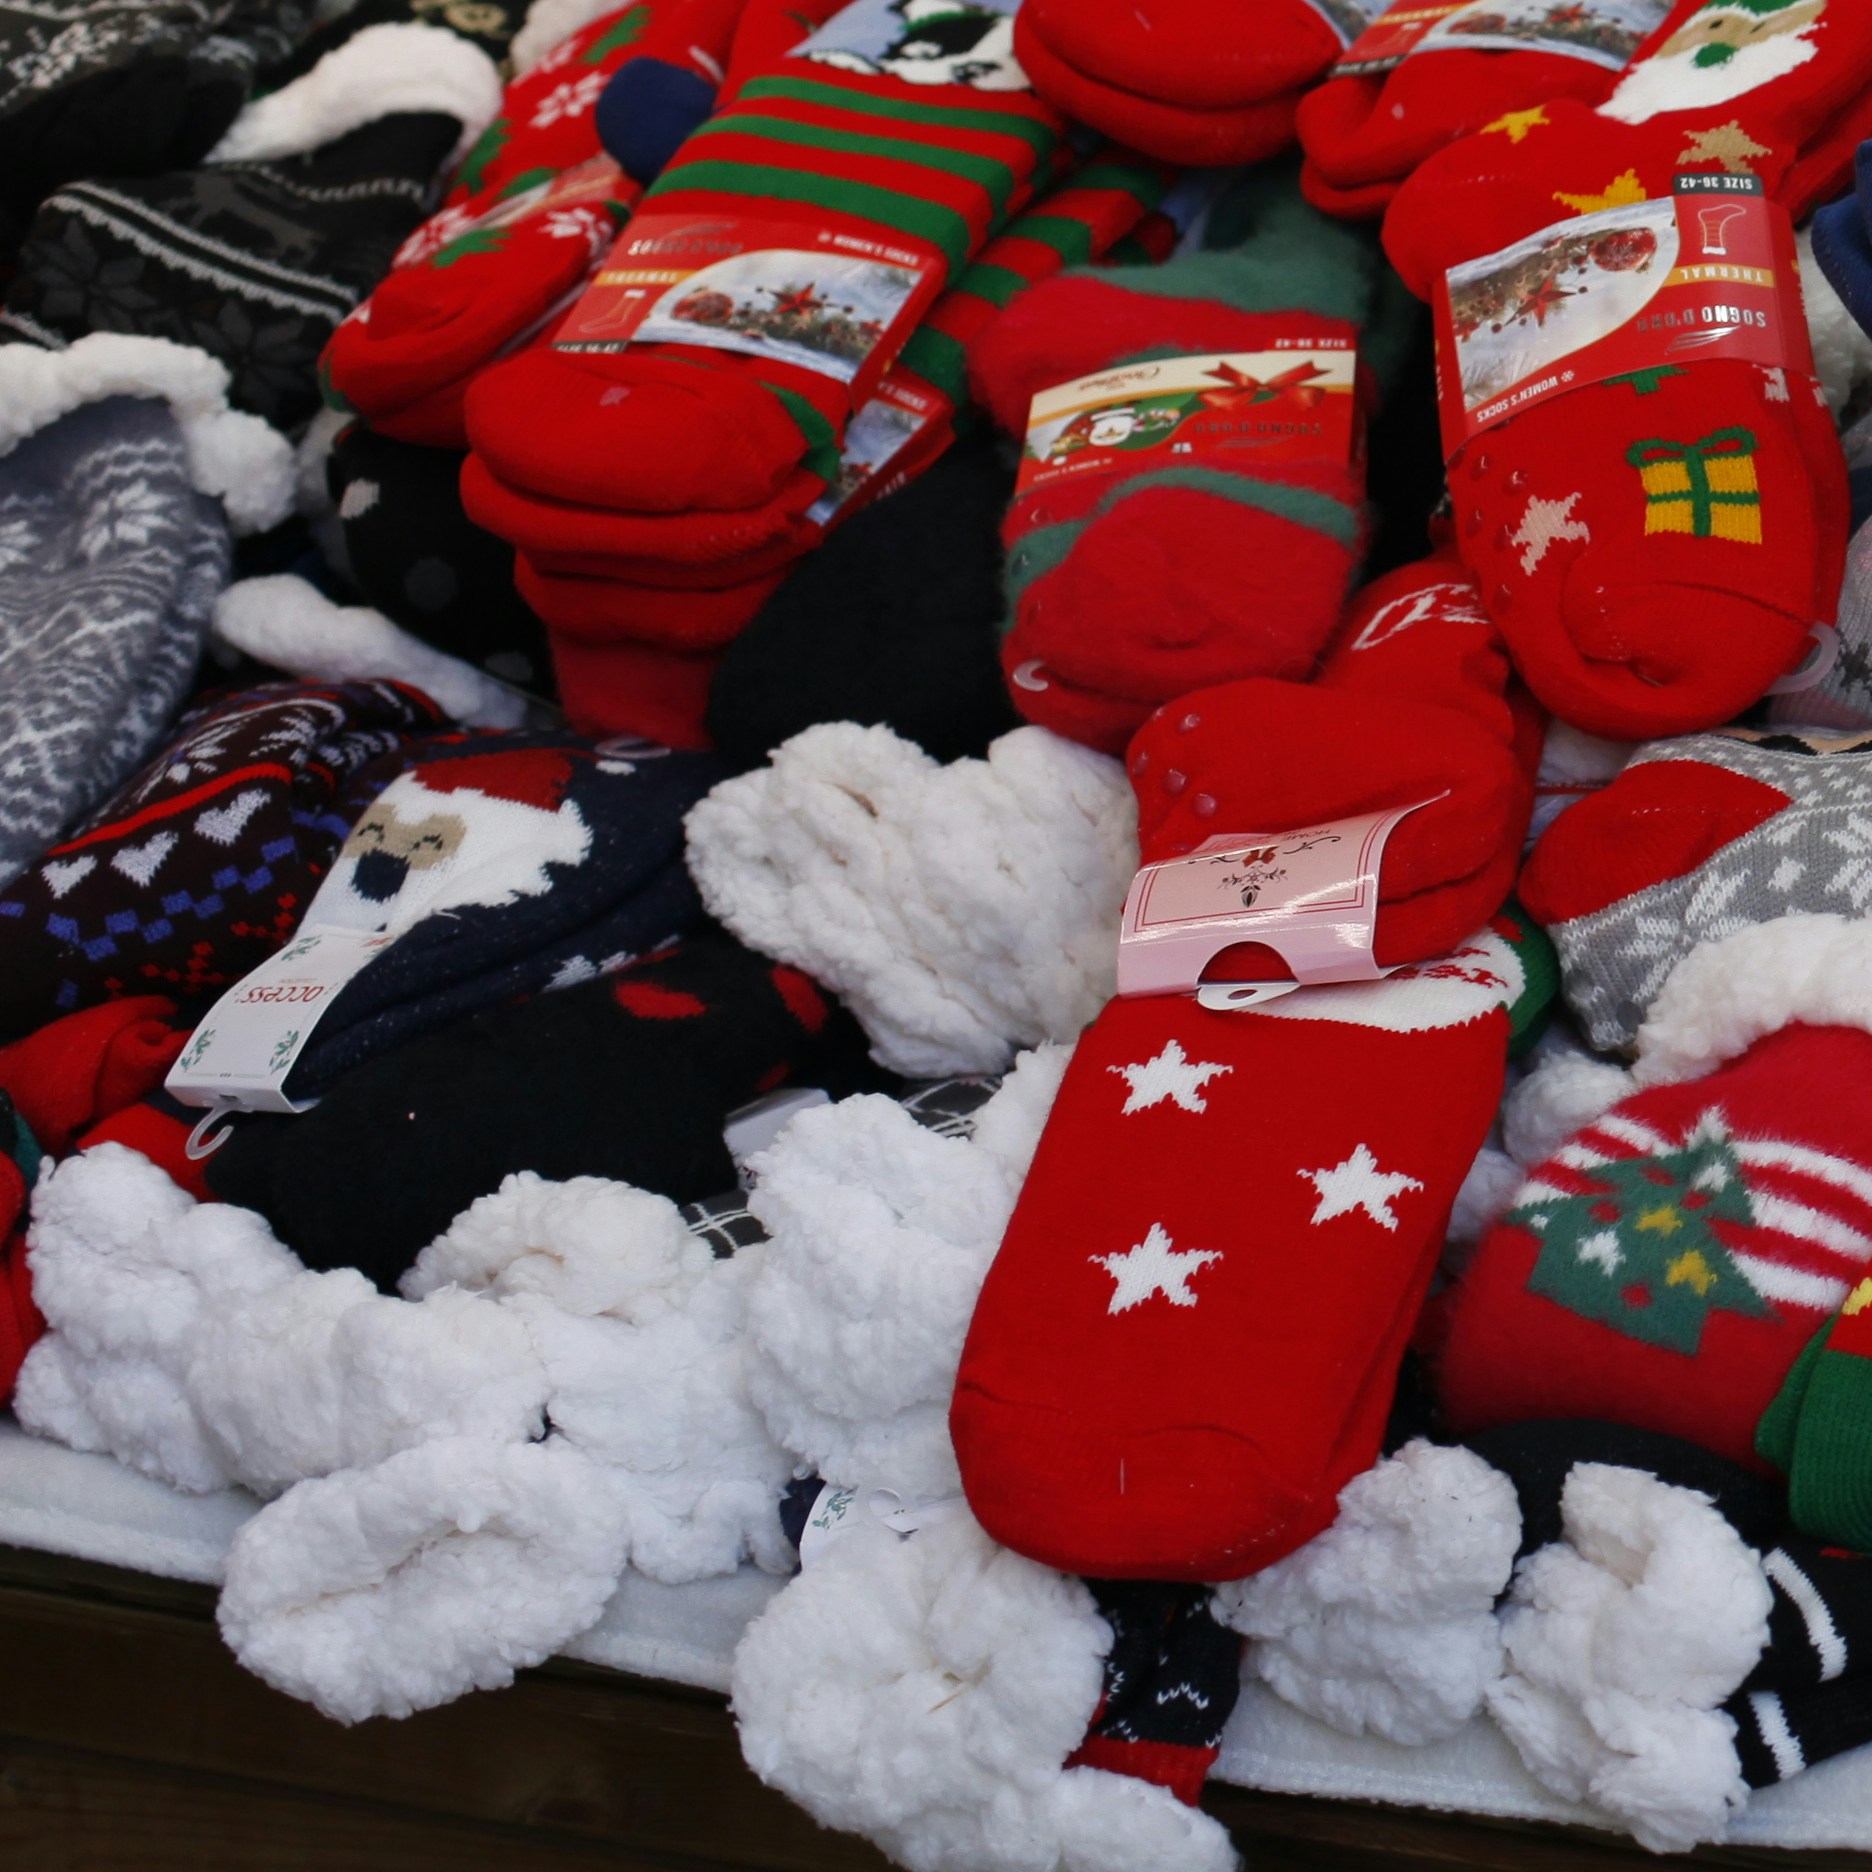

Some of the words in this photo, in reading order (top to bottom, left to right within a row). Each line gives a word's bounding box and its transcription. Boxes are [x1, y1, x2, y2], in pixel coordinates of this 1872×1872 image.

[1680, 177, 1716, 189] 36-42
[1723, 177, 1752, 190] SIZE
[1681, 266, 1763, 282] THERMAL
[1701, 305, 1767, 328] SOGNO
[1510, 375, 1559, 407] WOMEN'S
[1476, 398, 1509, 423] SOCKS
